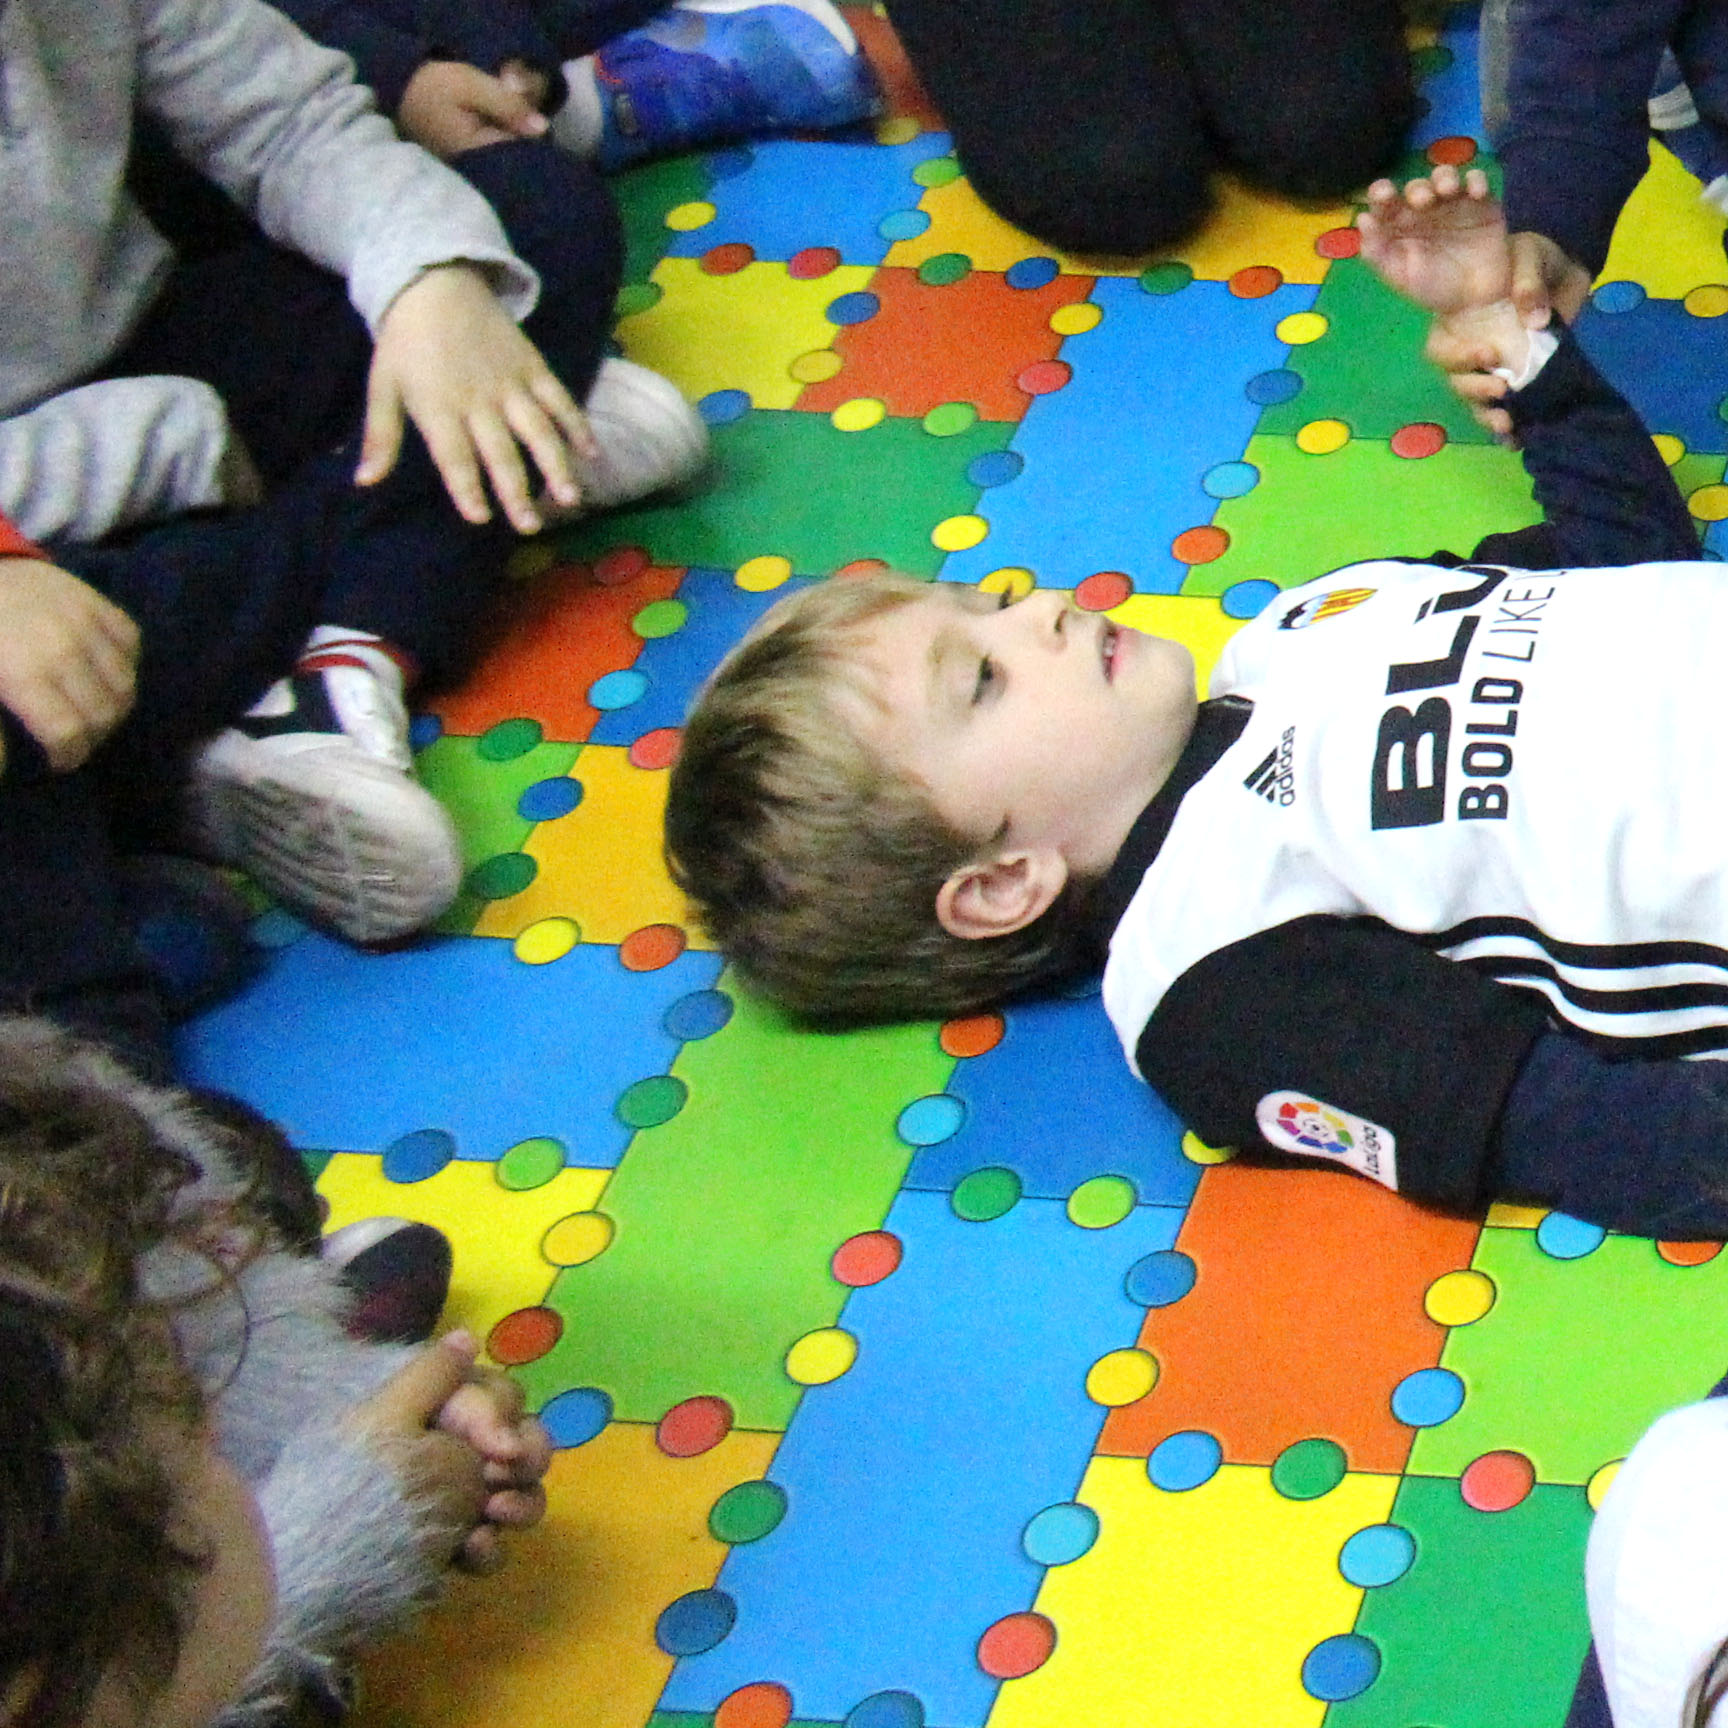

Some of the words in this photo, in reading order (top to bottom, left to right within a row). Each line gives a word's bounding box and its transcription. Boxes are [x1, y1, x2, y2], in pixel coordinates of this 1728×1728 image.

[1482, 586, 1556, 662] LIKE
[1276, 724, 1296, 808] adidas
[1457, 676, 1524, 821] BOLD
